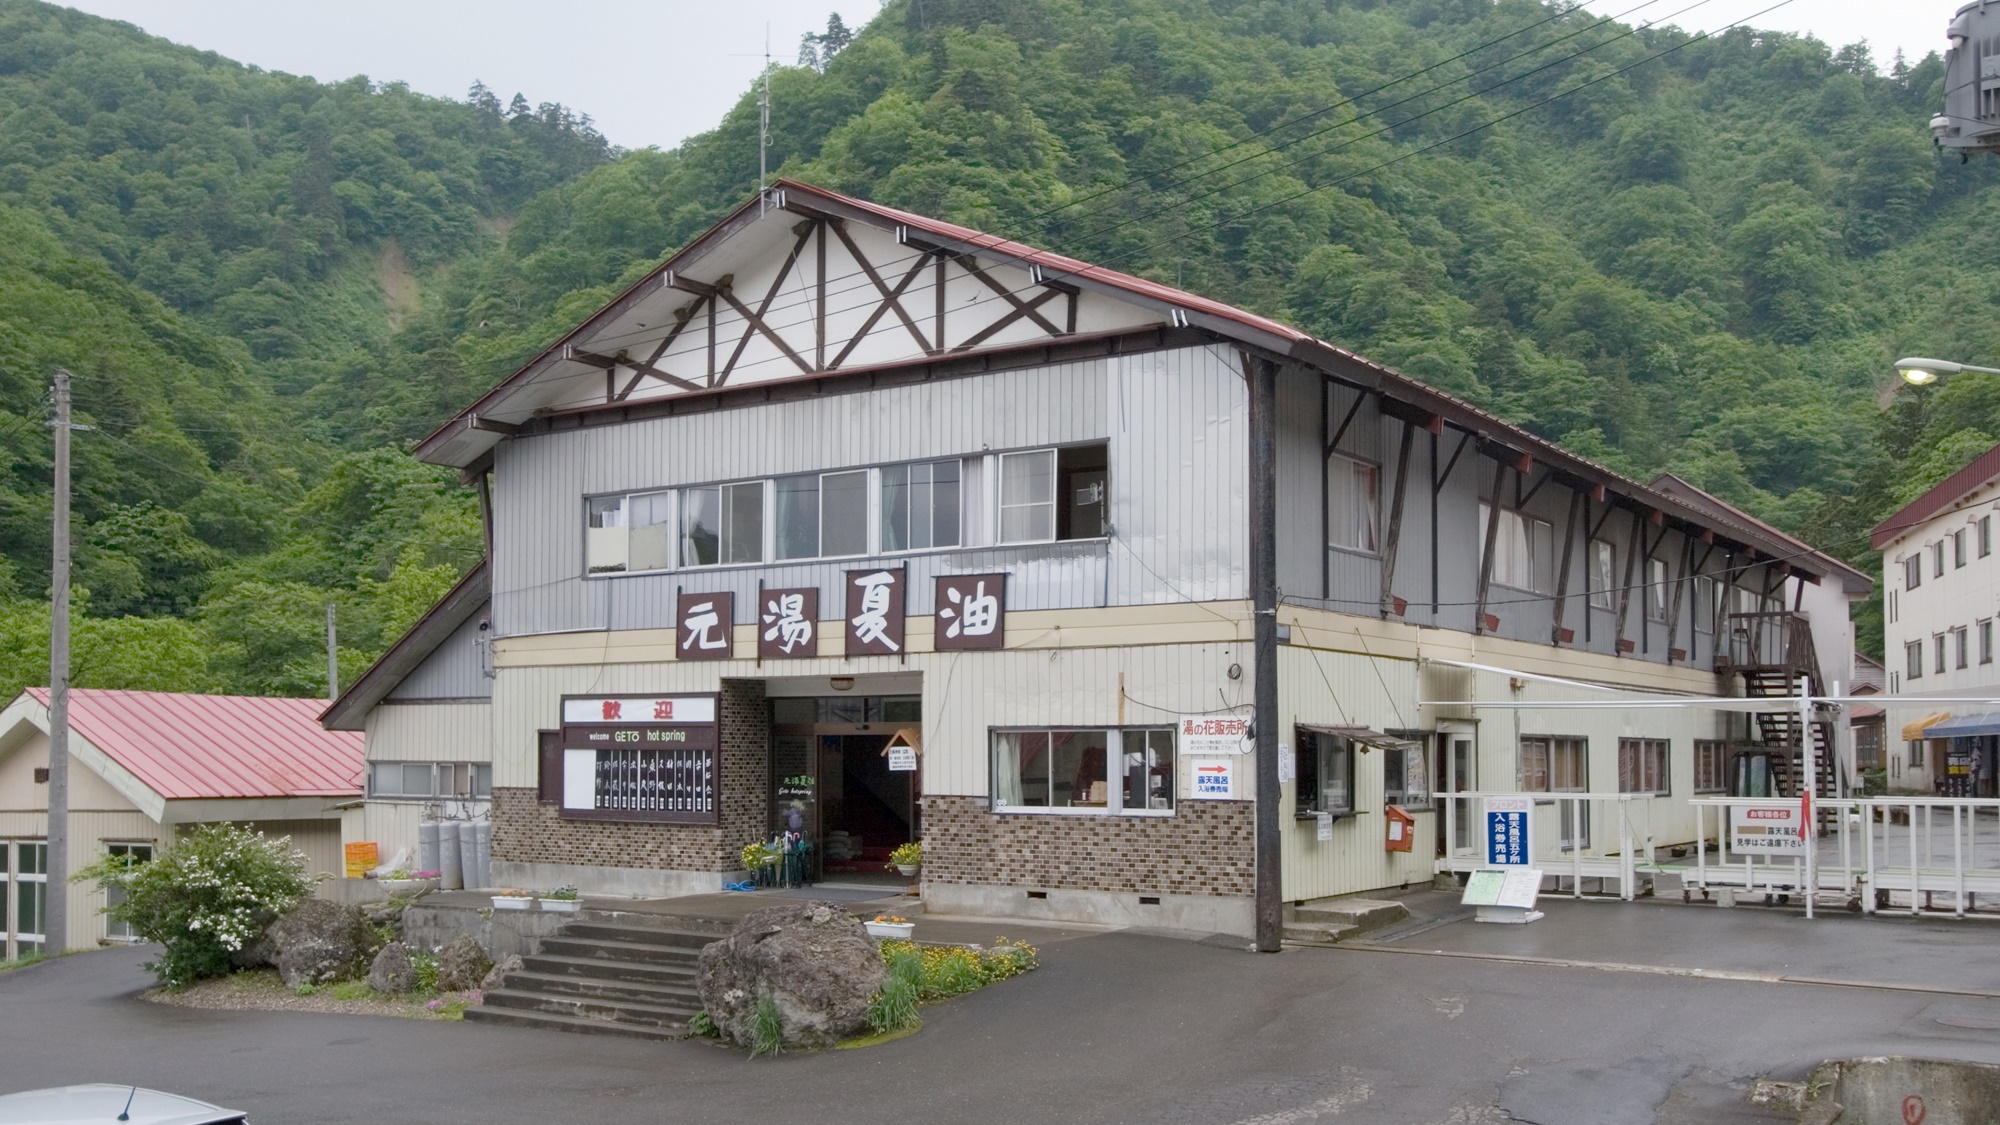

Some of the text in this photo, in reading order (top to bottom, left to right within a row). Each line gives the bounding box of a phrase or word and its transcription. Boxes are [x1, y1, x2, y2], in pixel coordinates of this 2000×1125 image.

[1183, 719, 1249, 736] 湯の花販売所
[589, 732, 609, 741] welcome
[647, 730, 659, 741] hot
[661, 730, 685, 742] spring
[1198, 776, 1229, 784] 露天風呂
[1491, 801, 1524, 809] フロント
[1495, 812, 1507, 864] 入浴券売場
[1737, 838, 1805, 848] 見学はご遠慮下さい
